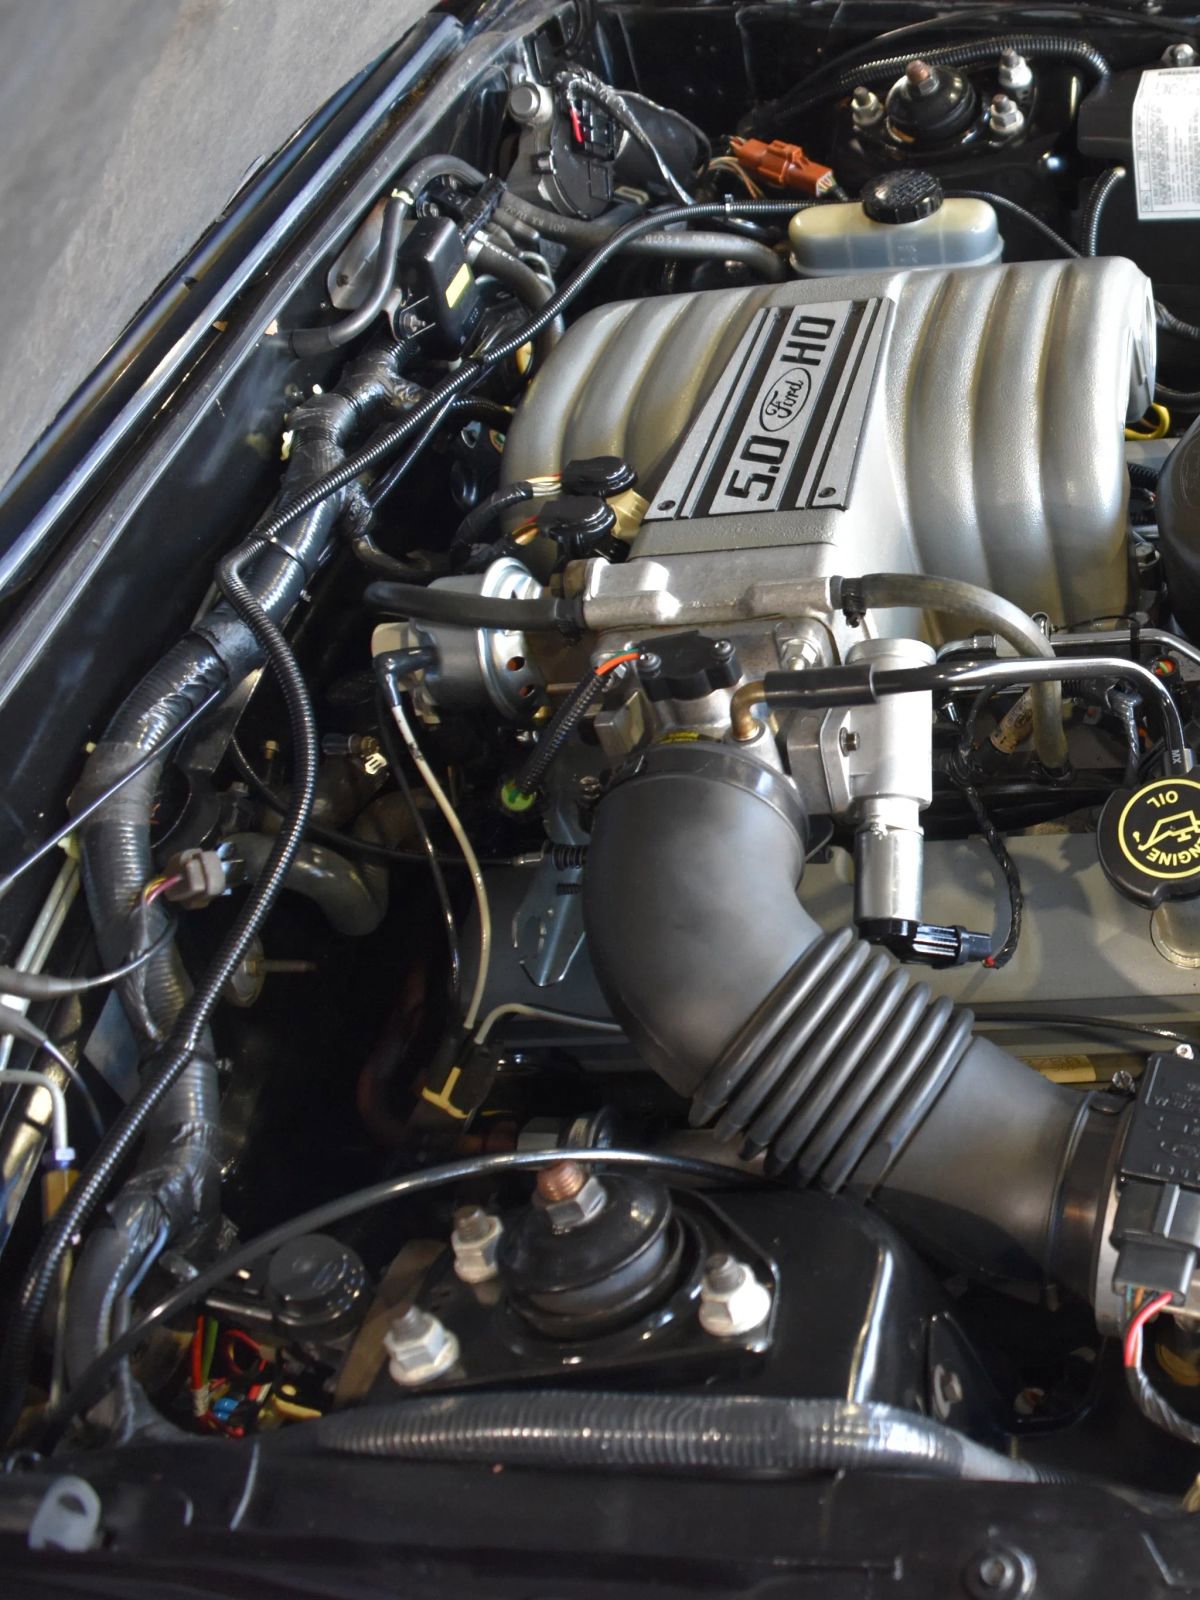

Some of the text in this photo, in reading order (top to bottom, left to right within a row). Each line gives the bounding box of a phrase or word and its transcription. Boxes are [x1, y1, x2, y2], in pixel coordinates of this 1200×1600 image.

[724, 435, 790, 502] 5.0
[780, 316, 836, 366] HO
[1147, 790, 1178, 808] OIL
